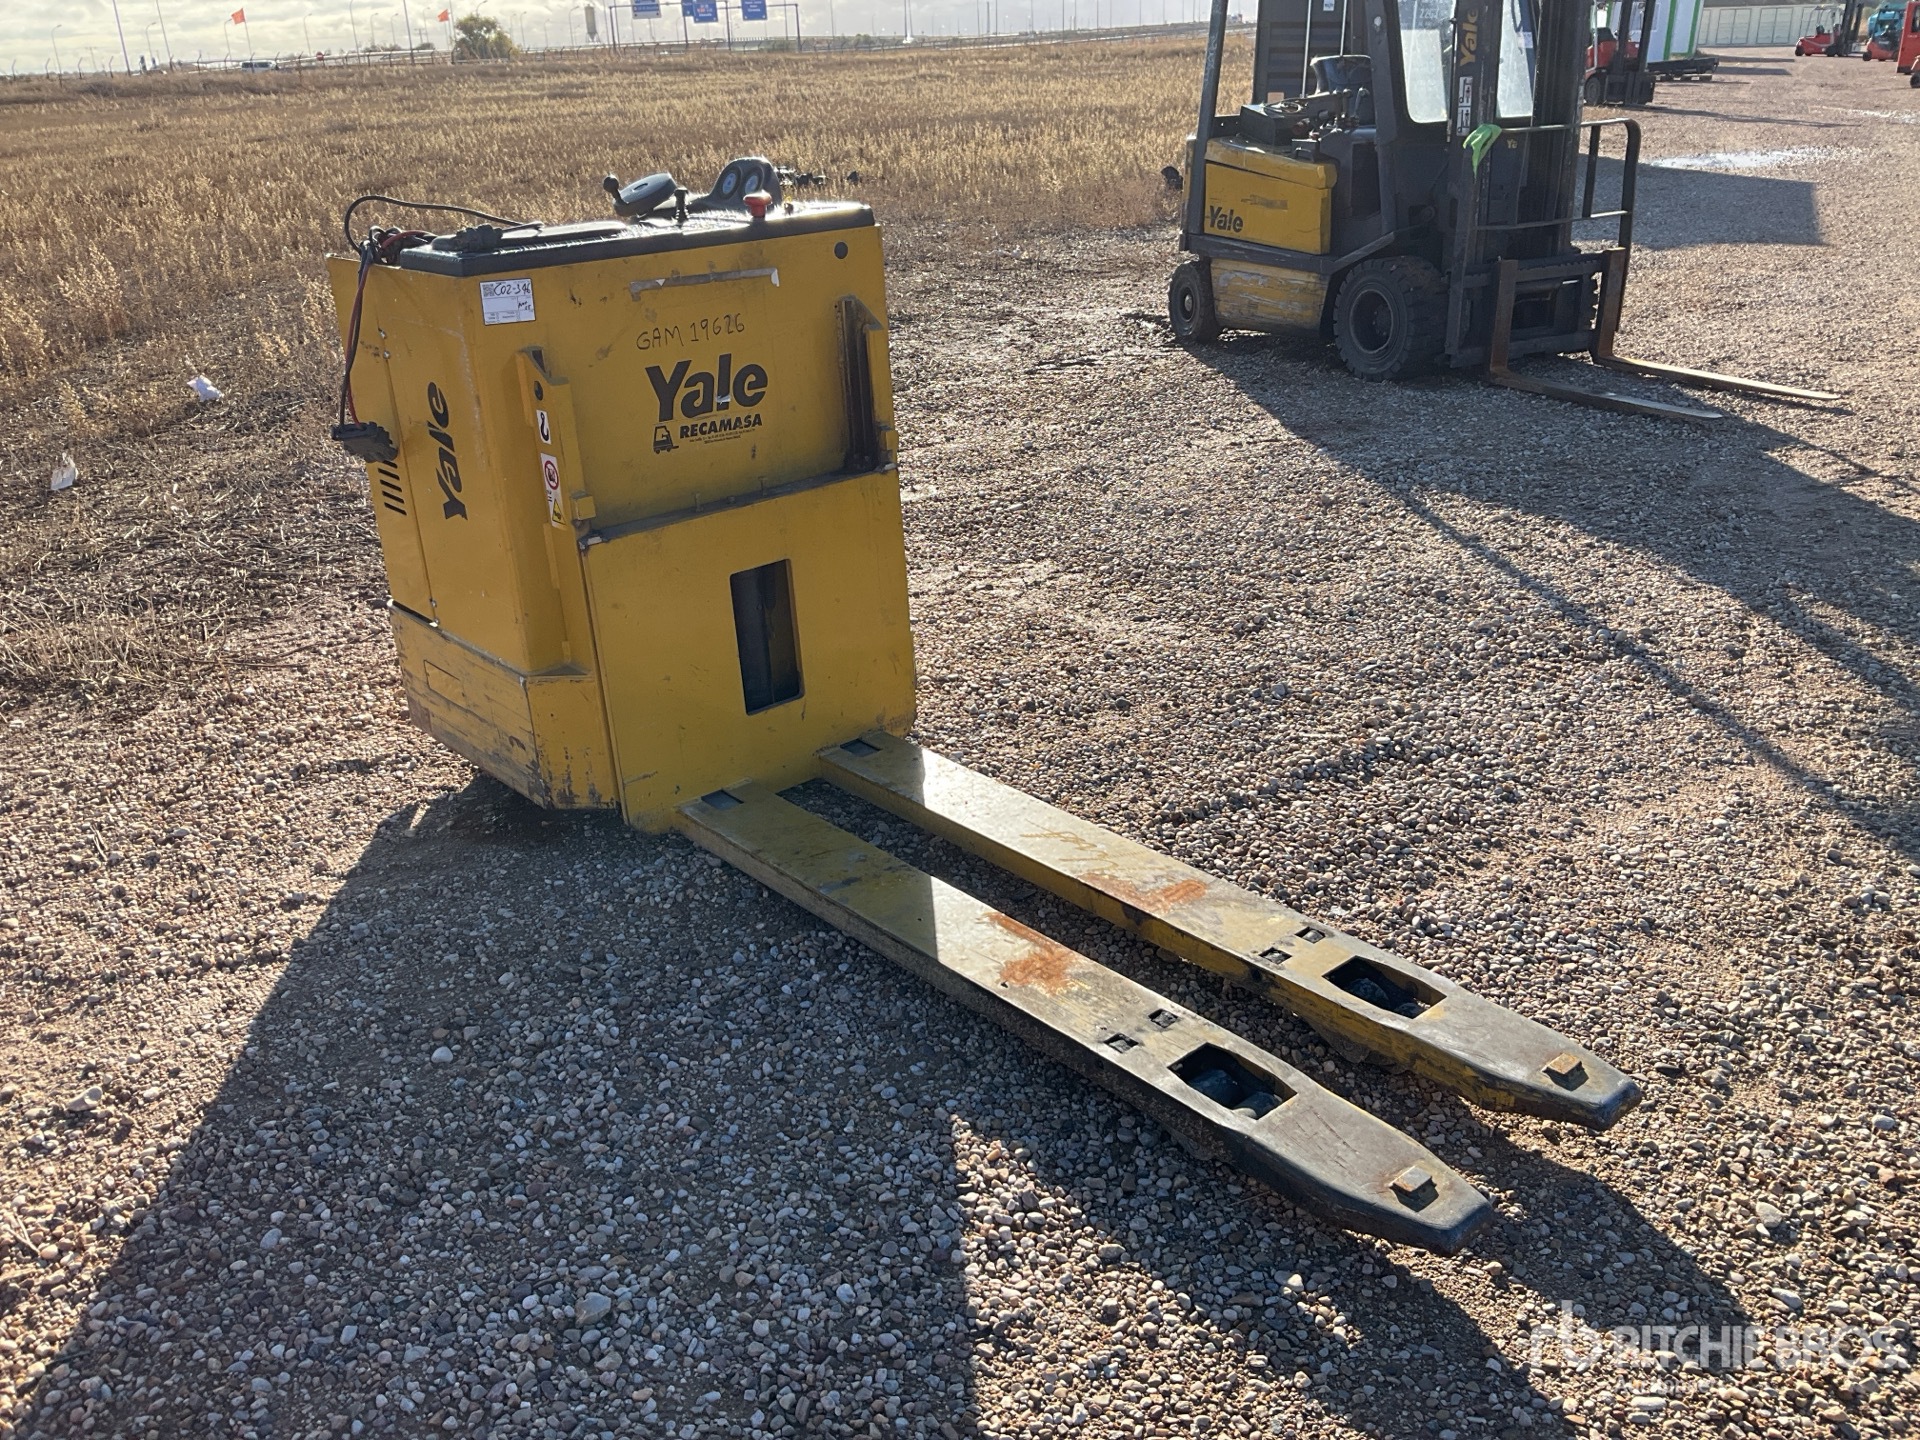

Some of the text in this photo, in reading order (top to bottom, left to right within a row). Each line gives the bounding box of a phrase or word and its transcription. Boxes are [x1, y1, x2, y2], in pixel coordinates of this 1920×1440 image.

[1460, 8, 1479, 67] Yale
[1209, 205, 1244, 233] Yale
[636, 312, 745, 350] GAM 19626
[645, 353, 768, 422] Yale
[679, 413, 763, 439] RECAMASA
[427, 381, 469, 520] Yale
